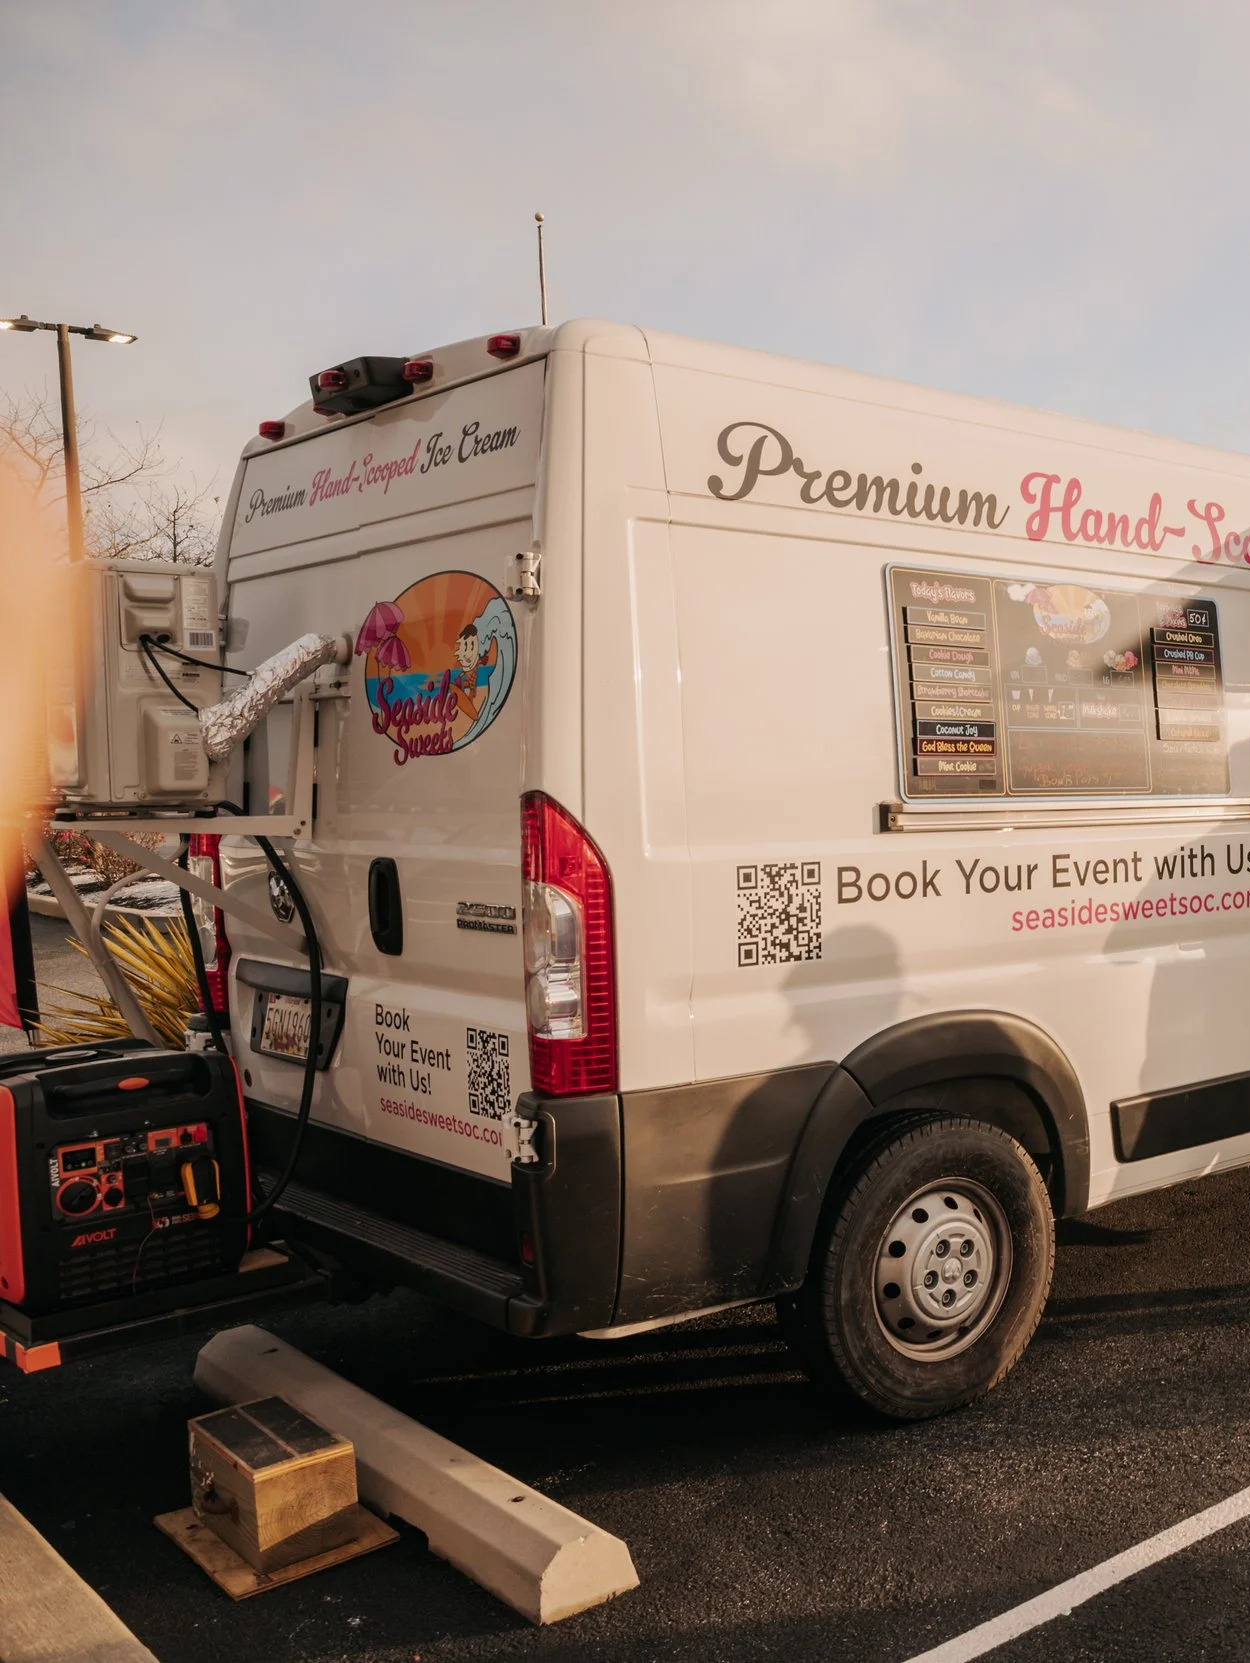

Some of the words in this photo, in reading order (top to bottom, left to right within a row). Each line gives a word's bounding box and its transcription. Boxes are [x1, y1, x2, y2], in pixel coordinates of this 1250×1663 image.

[245, 486, 308, 523] Premium
[309, 439, 421, 506] Hand-Scooped
[421, 432, 454, 474] Ice
[457, 421, 521, 463] Cream
[707, 421, 1010, 530] Premium
[911, 583, 943, 602] Today's
[926, 611, 949, 624] Vanilla
[950, 614, 968, 625] Bean
[1189, 613, 1206, 625] 50¢
[948, 632, 980, 643] Chocolate
[1166, 632, 1188, 643] Crushed
[1188, 634, 1202, 643] Oreo
[929, 649, 951, 660] Cookie
[952, 651, 973, 664] Dough
[1164, 649, 1186, 659] Crushed
[1187, 650, 1194, 660] PB
[1194, 653, 1205, 661] Cup
[930, 668, 953, 678] Cotton
[954, 669, 976, 682] Candy
[916, 685, 956, 698] Strawberry
[372, 669, 459, 734] Seaside
[936, 724, 964, 735] Coconut
[965, 724, 978, 737] Joy
[394, 724, 454, 766] Sweets
[922, 741, 936, 752] God
[937, 741, 955, 752] Bless
[956, 742, 968, 752] the
[969, 742, 992, 752] Queen
[938, 760, 955, 772] Mint
[955, 761, 976, 772] Cookie
[837, 860, 942, 904] Book
[955, 858, 1038, 895] Your
[1052, 851, 1142, 888] Event
[1154, 845, 1215, 880] with
[456, 918, 518, 935] PROMASTER
[375, 1003, 410, 1032] Book
[375, 1032, 406, 1060] Your
[410, 1040, 451, 1071] Event
[377, 1062, 405, 1088] with
[410, 1068, 432, 1095] Us!
[380, 1098, 503, 1147] seasidesweetsoc.co
[50, 1158, 60, 1188] AIVOLT
[71, 1228, 117, 1248] AIVOLT
